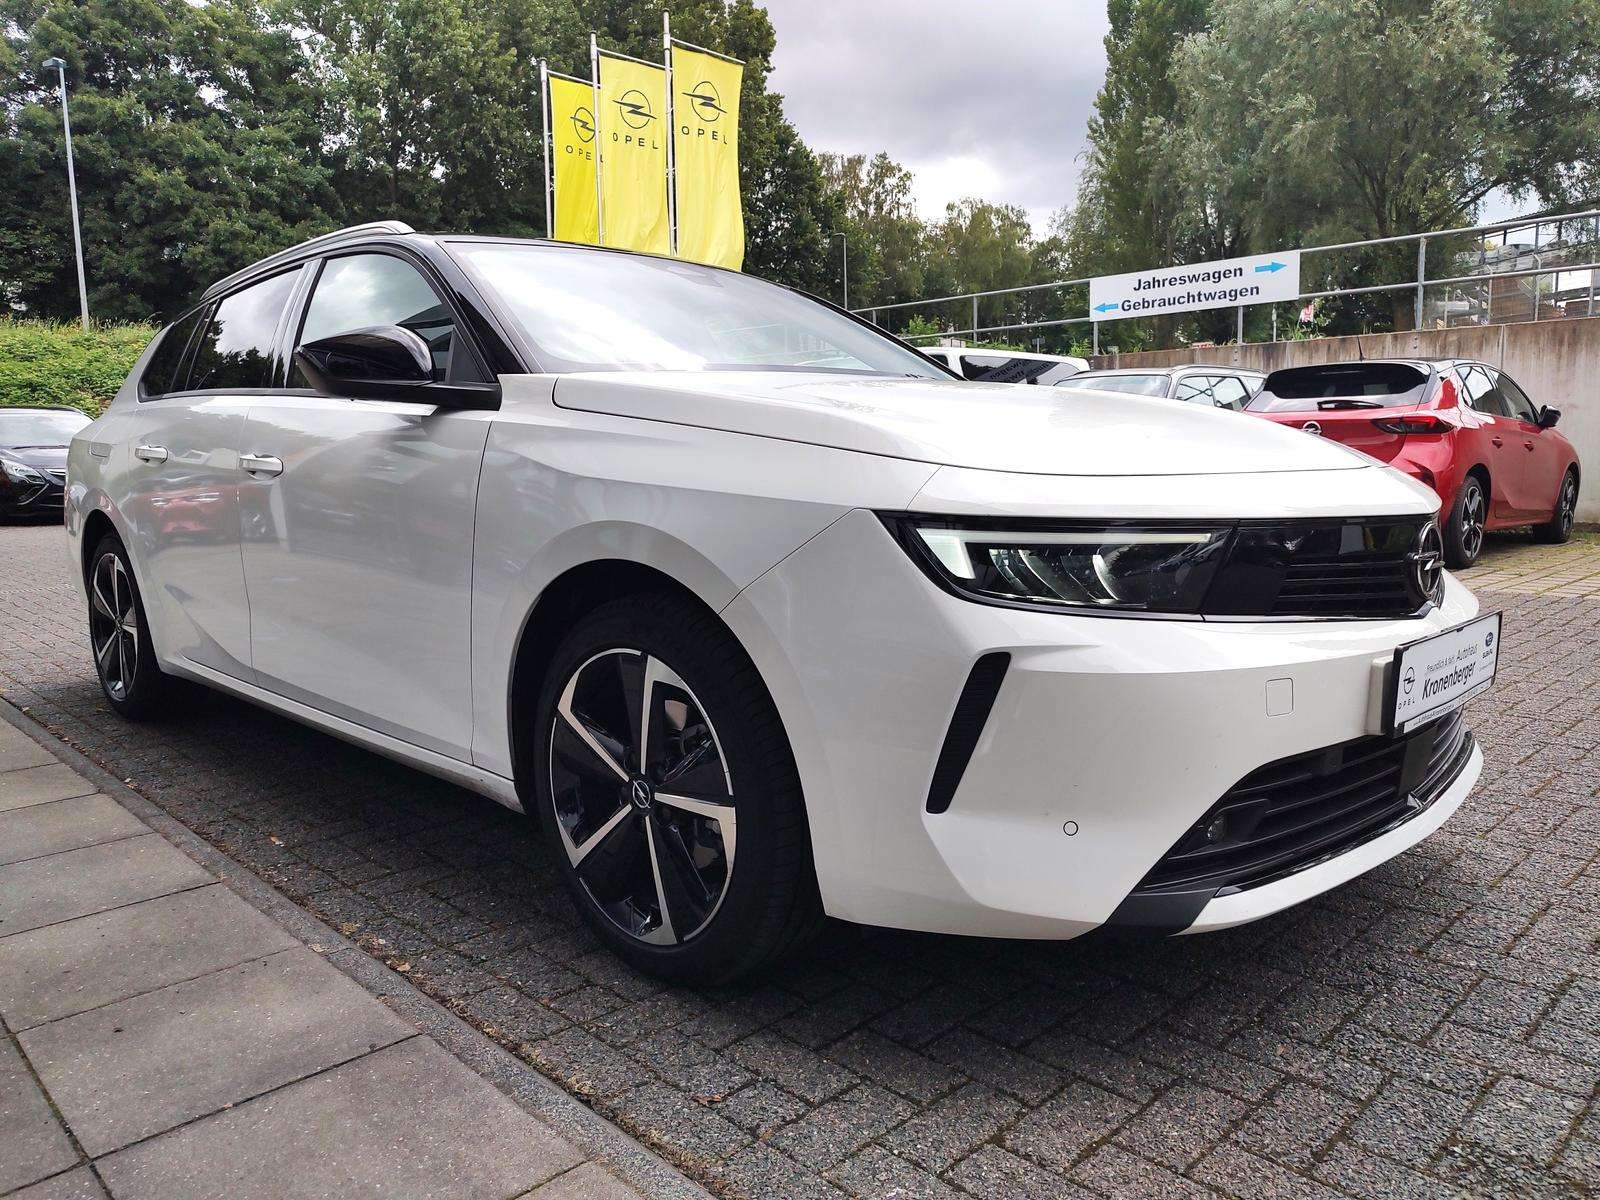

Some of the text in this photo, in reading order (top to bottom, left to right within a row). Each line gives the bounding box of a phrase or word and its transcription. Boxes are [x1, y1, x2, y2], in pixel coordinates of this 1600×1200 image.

[612, 132, 659, 150] OPEL
[681, 126, 728, 145] OPEL
[1133, 265, 1243, 291] Jahreswagen
[1121, 284, 1260, 312] Gebrauchtwagen
[1457, 644, 1478, 661] Autohaus
[1422, 661, 1476, 700] Kronenberger
[1398, 699, 1415, 710] OPEL
